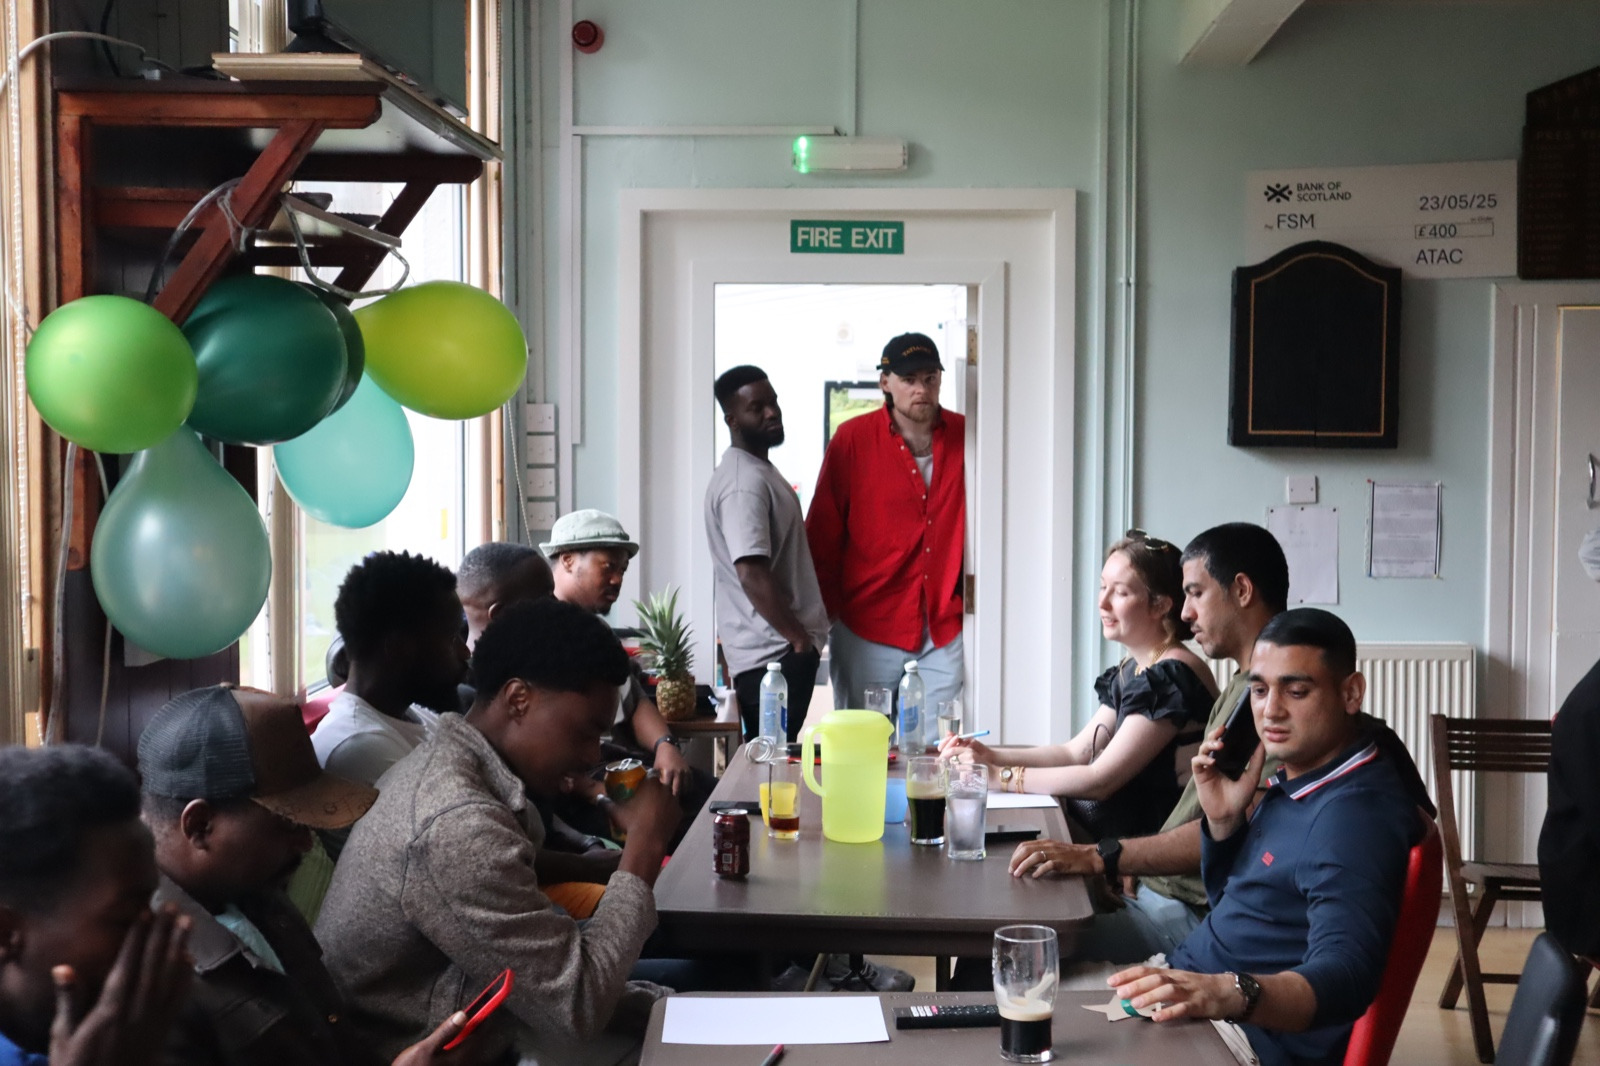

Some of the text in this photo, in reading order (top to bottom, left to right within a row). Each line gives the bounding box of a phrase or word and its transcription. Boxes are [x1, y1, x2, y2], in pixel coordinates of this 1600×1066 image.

[1296, 181, 1342, 192] BANK OF
[1296, 191, 1352, 202] SCOTLAND
[1419, 193, 1498, 211] 23/05/25
[1276, 213, 1315, 230] FSM
[797, 226, 898, 249] FIRE EXIT
[1415, 248, 1463, 265] ATAC
